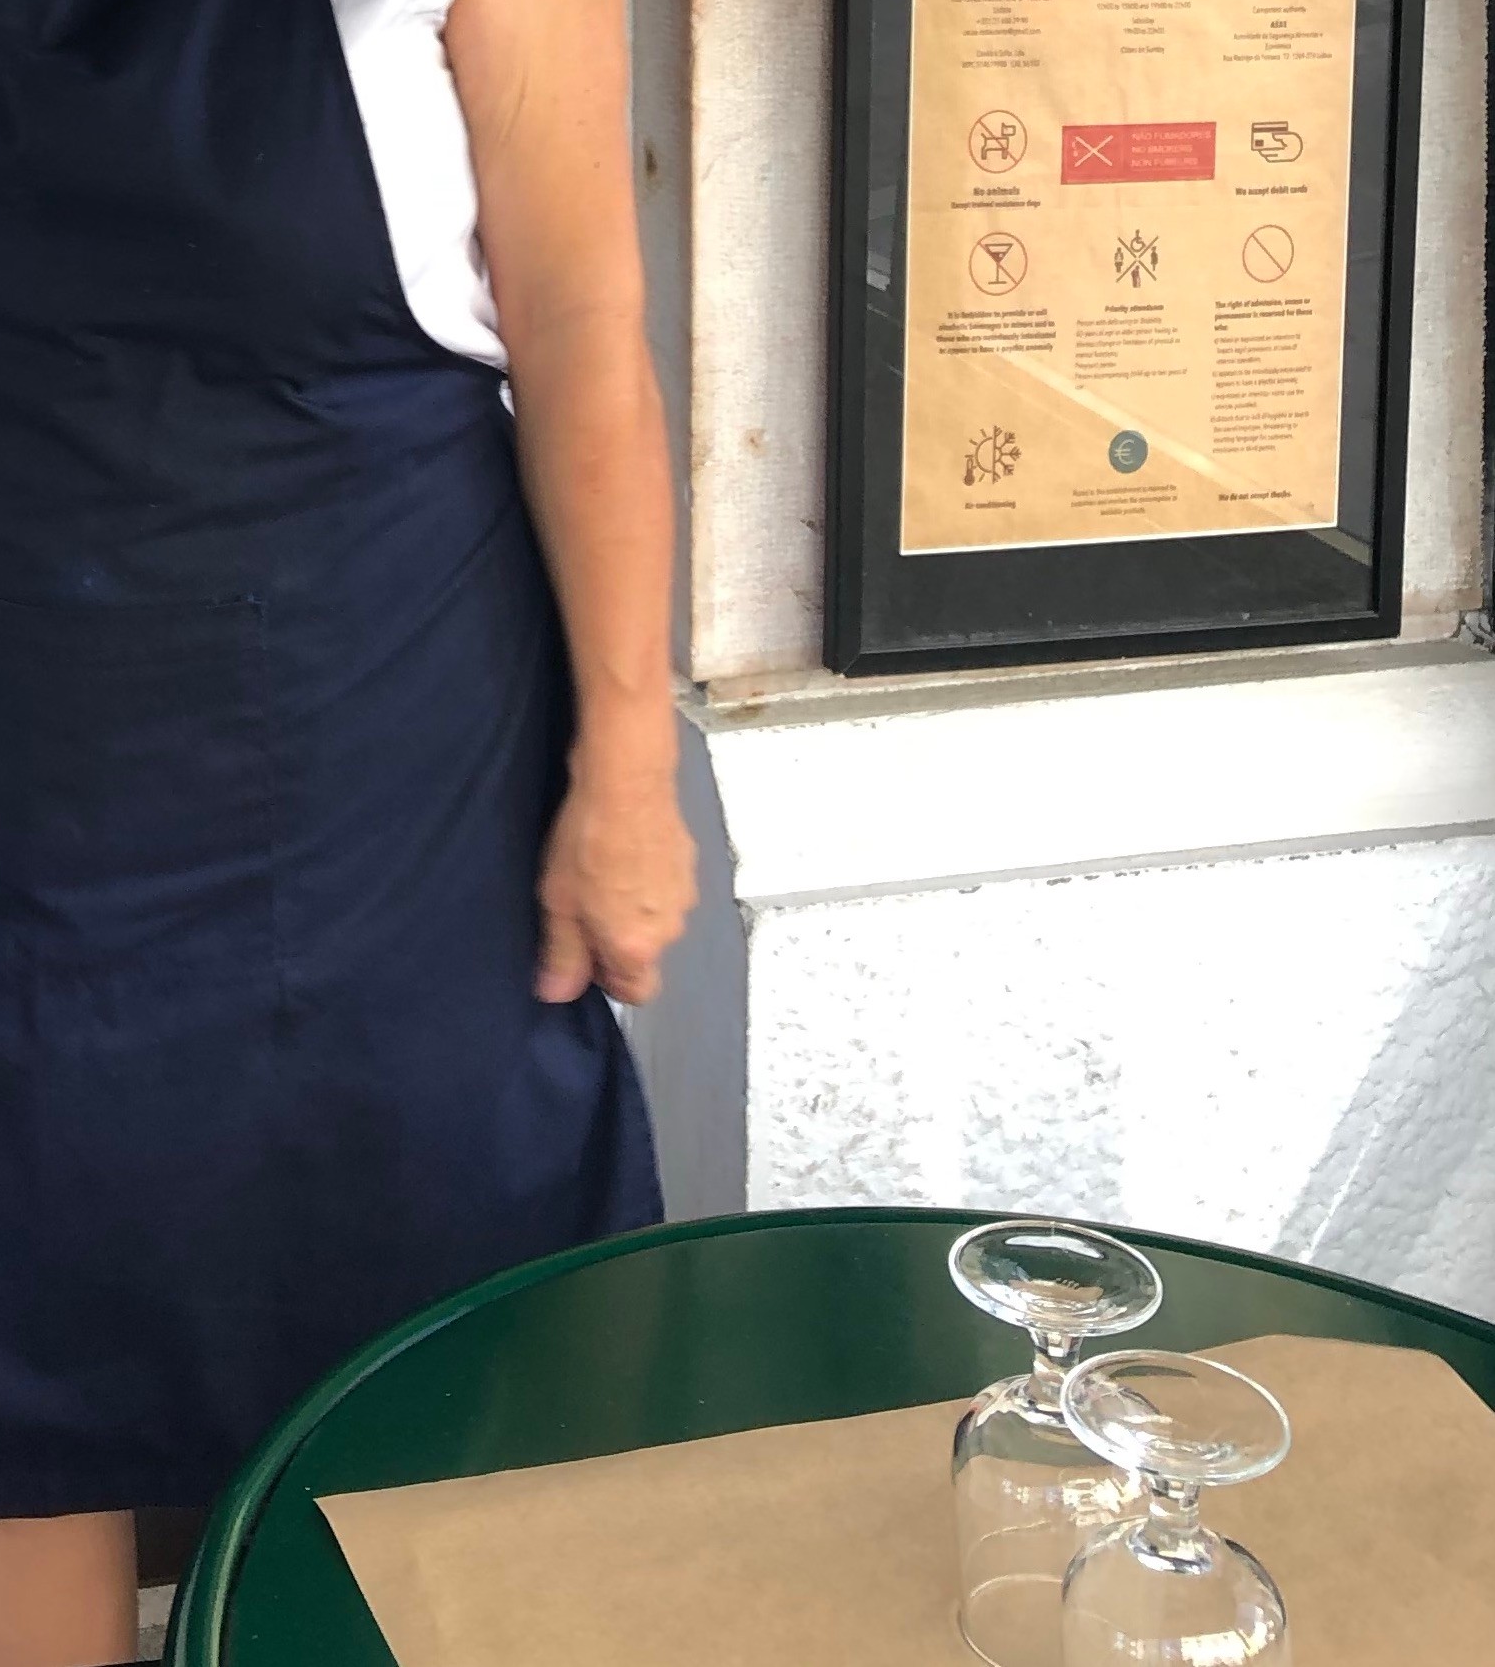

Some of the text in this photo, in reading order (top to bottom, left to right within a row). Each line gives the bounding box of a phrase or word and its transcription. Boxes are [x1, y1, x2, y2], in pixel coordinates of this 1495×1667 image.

[973, 186, 1020, 196] No animals
[1235, 184, 1308, 196] We accept debit cards
